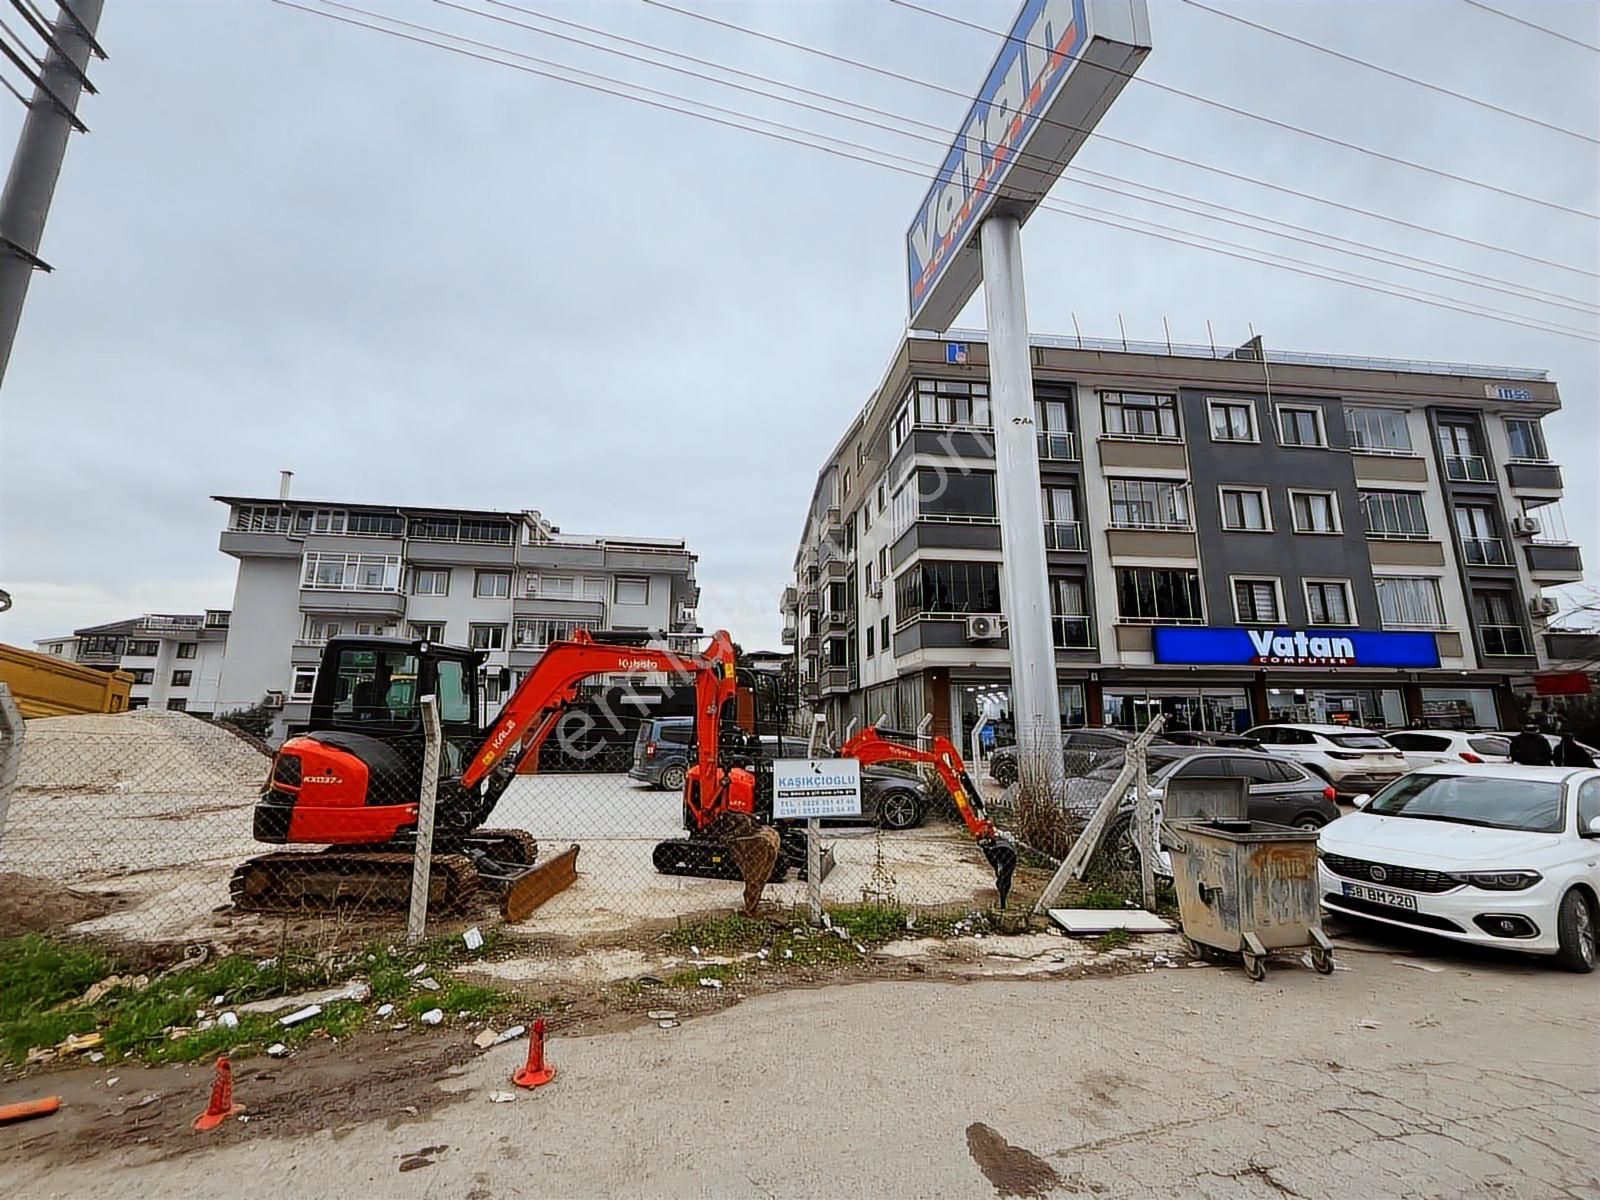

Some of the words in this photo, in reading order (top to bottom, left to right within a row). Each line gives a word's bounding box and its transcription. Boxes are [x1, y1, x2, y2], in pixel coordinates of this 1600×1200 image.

[911, 0, 1075, 272] Vatan
[1248, 630, 1355, 658] Vatan
[618, 657, 658, 669] Kubota
[1260, 656, 1348, 664] COMPUTER
[1367, 888, 1386, 903] BM
[1388, 893, 1413, 908] 220
